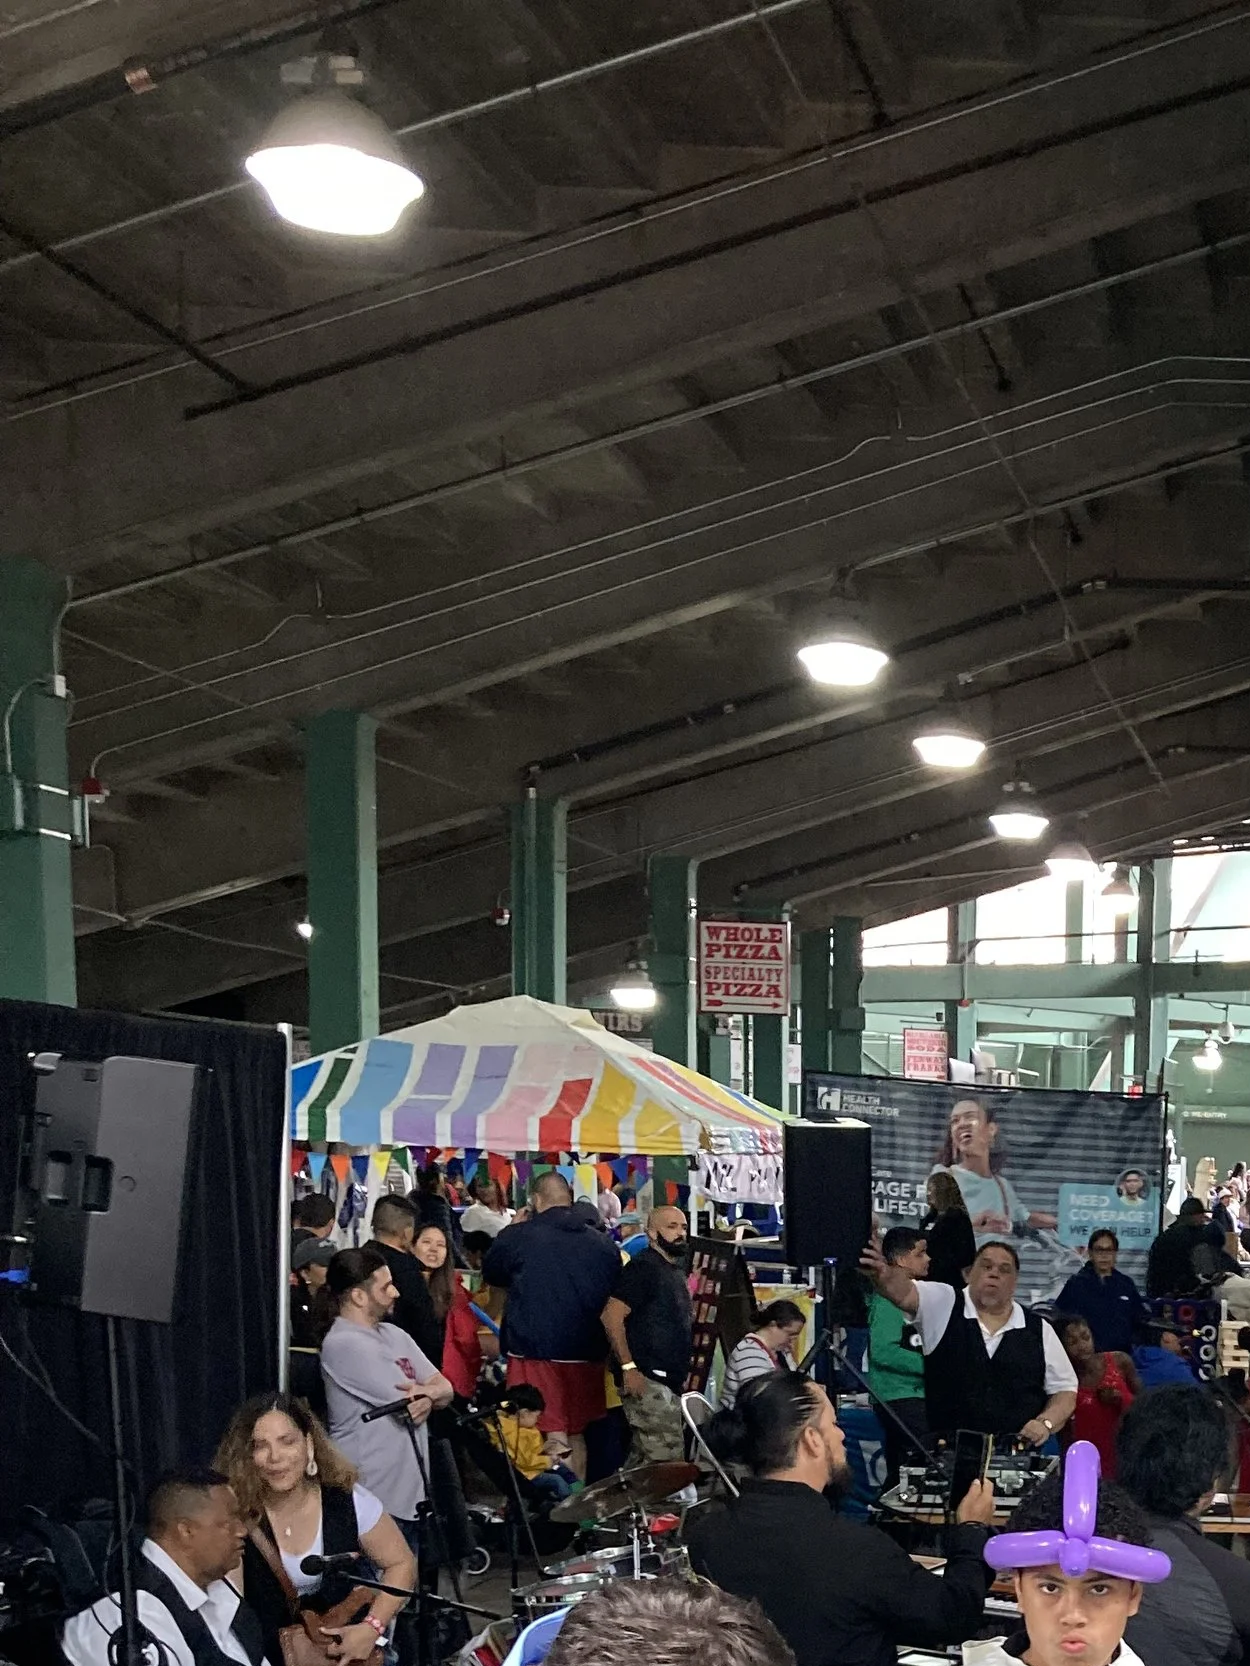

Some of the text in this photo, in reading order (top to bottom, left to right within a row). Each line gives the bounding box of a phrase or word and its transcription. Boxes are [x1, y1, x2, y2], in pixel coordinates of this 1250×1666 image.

[705, 926, 783, 944] WHOLE
[704, 943, 783, 961] PIZZA
[704, 965, 784, 983] SPECIALTY
[704, 982, 783, 999] PIZZA
[842, 1093, 881, 1106] HEALTH
[841, 1102, 900, 1117] CONNECTOR
[1069, 1194, 1110, 1208] NEED
[1069, 1208, 1154, 1223] COVERAGE?
